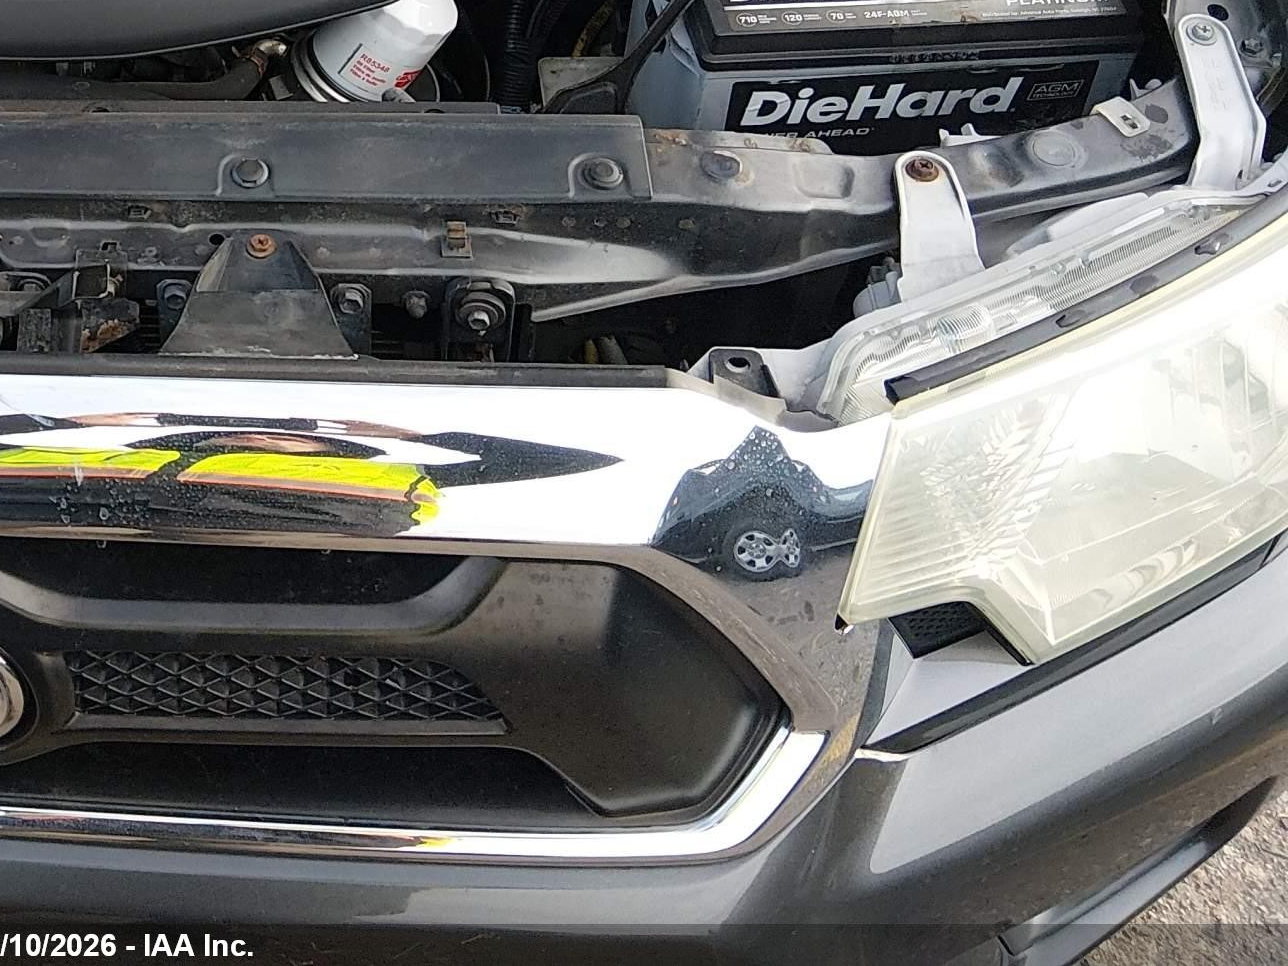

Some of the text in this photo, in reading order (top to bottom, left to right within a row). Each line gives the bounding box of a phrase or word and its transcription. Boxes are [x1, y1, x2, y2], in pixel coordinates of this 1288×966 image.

[739, 15, 758, 24] 710
[784, 14, 803, 22] 120
[830, 12, 844, 20] 70
[1035, 83, 1079, 93] AGM
[740, 77, 1024, 126] DieHard
[805, 128, 870, 138] AHEAD
